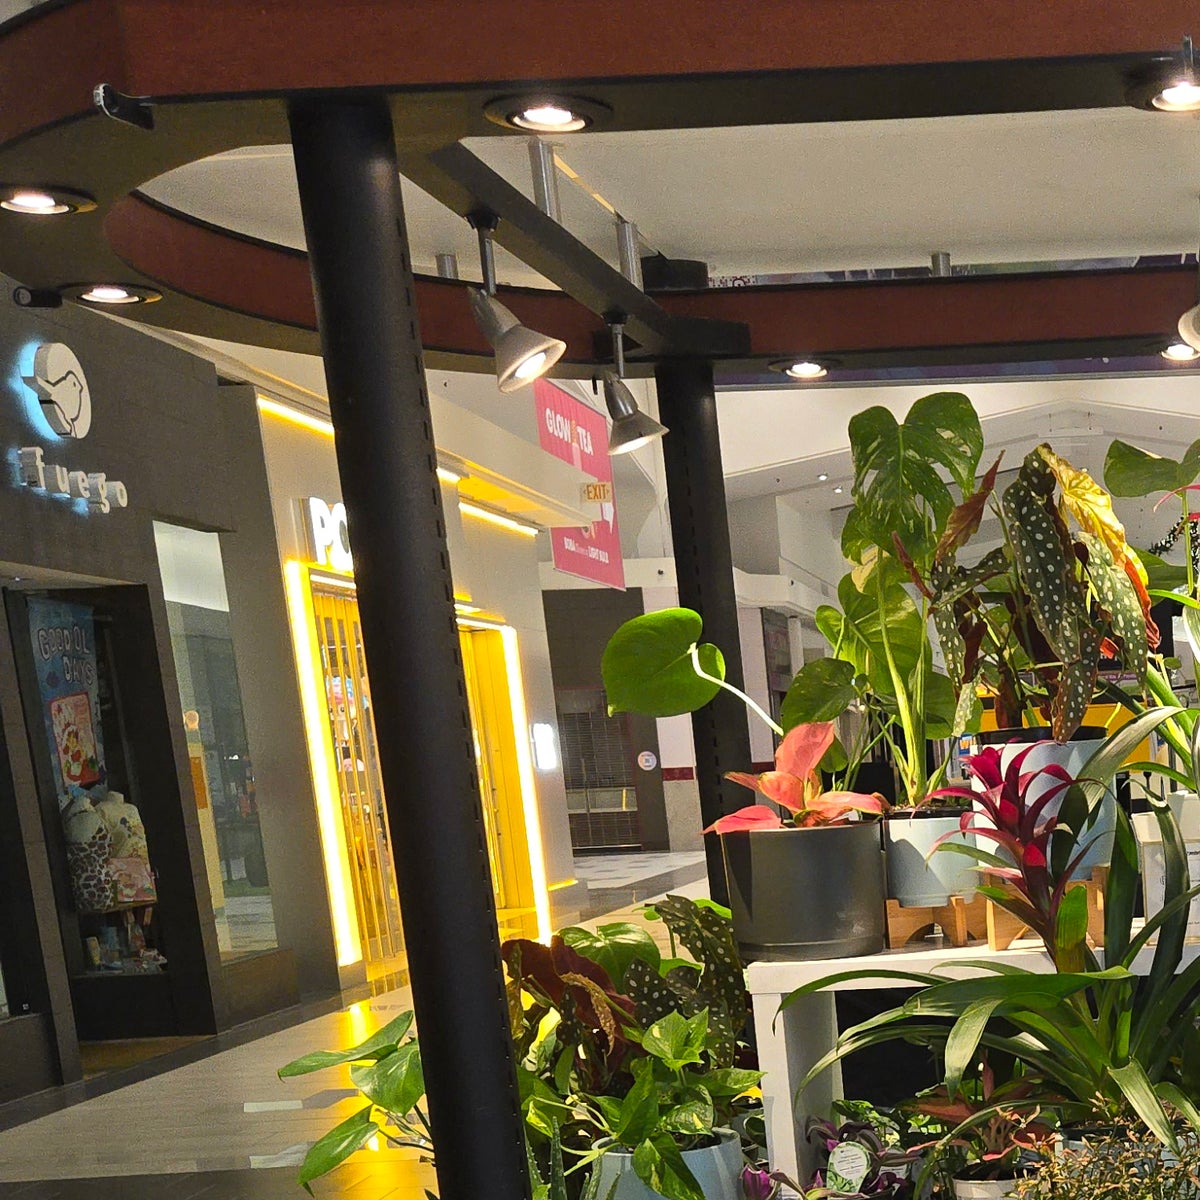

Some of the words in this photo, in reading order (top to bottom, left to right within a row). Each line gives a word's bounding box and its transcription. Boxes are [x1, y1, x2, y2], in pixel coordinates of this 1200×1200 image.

[545, 407, 572, 444] GLOW
[576, 425, 594, 456] TEA
[28, 446, 128, 514] fuego
[586, 484, 607, 500] EXIT
[37, 627, 71, 662] GOOD
[62, 654, 95, 686] DAYS
